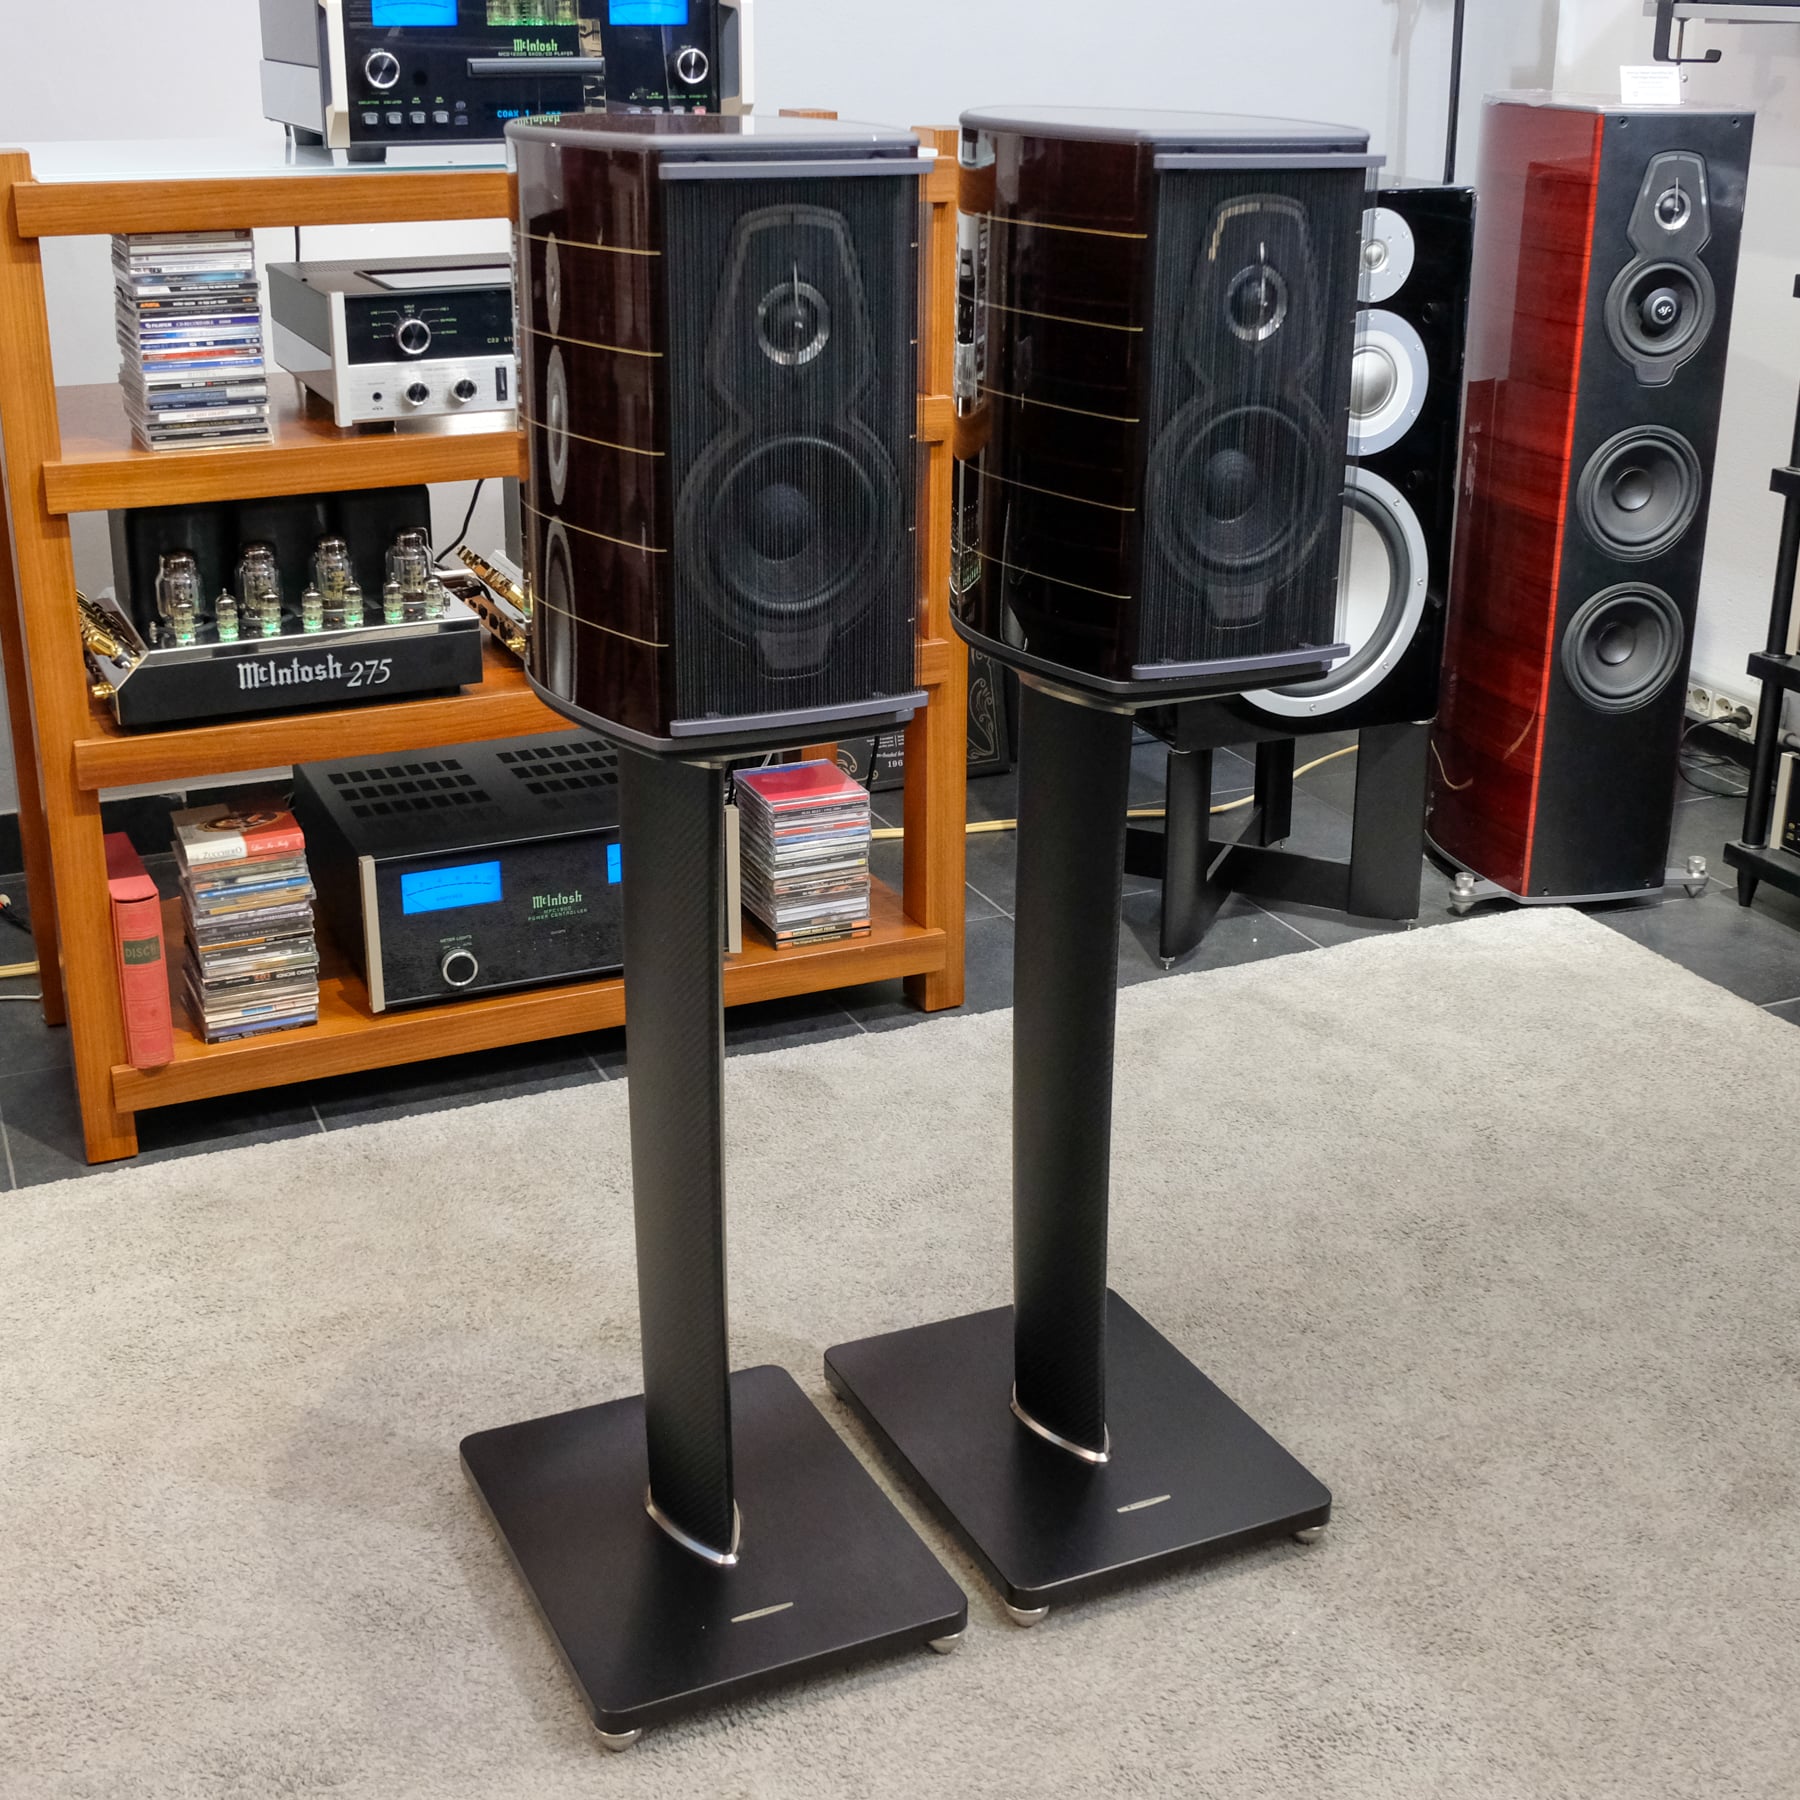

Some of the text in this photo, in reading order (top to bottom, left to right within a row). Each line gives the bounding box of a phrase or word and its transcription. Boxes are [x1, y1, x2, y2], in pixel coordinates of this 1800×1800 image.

[513, 39, 558, 52] McIntosh
[497, 109, 519, 118] COAX
[237, 653, 392, 690] McIntosh 275
[532, 890, 582, 909] McIntosh
